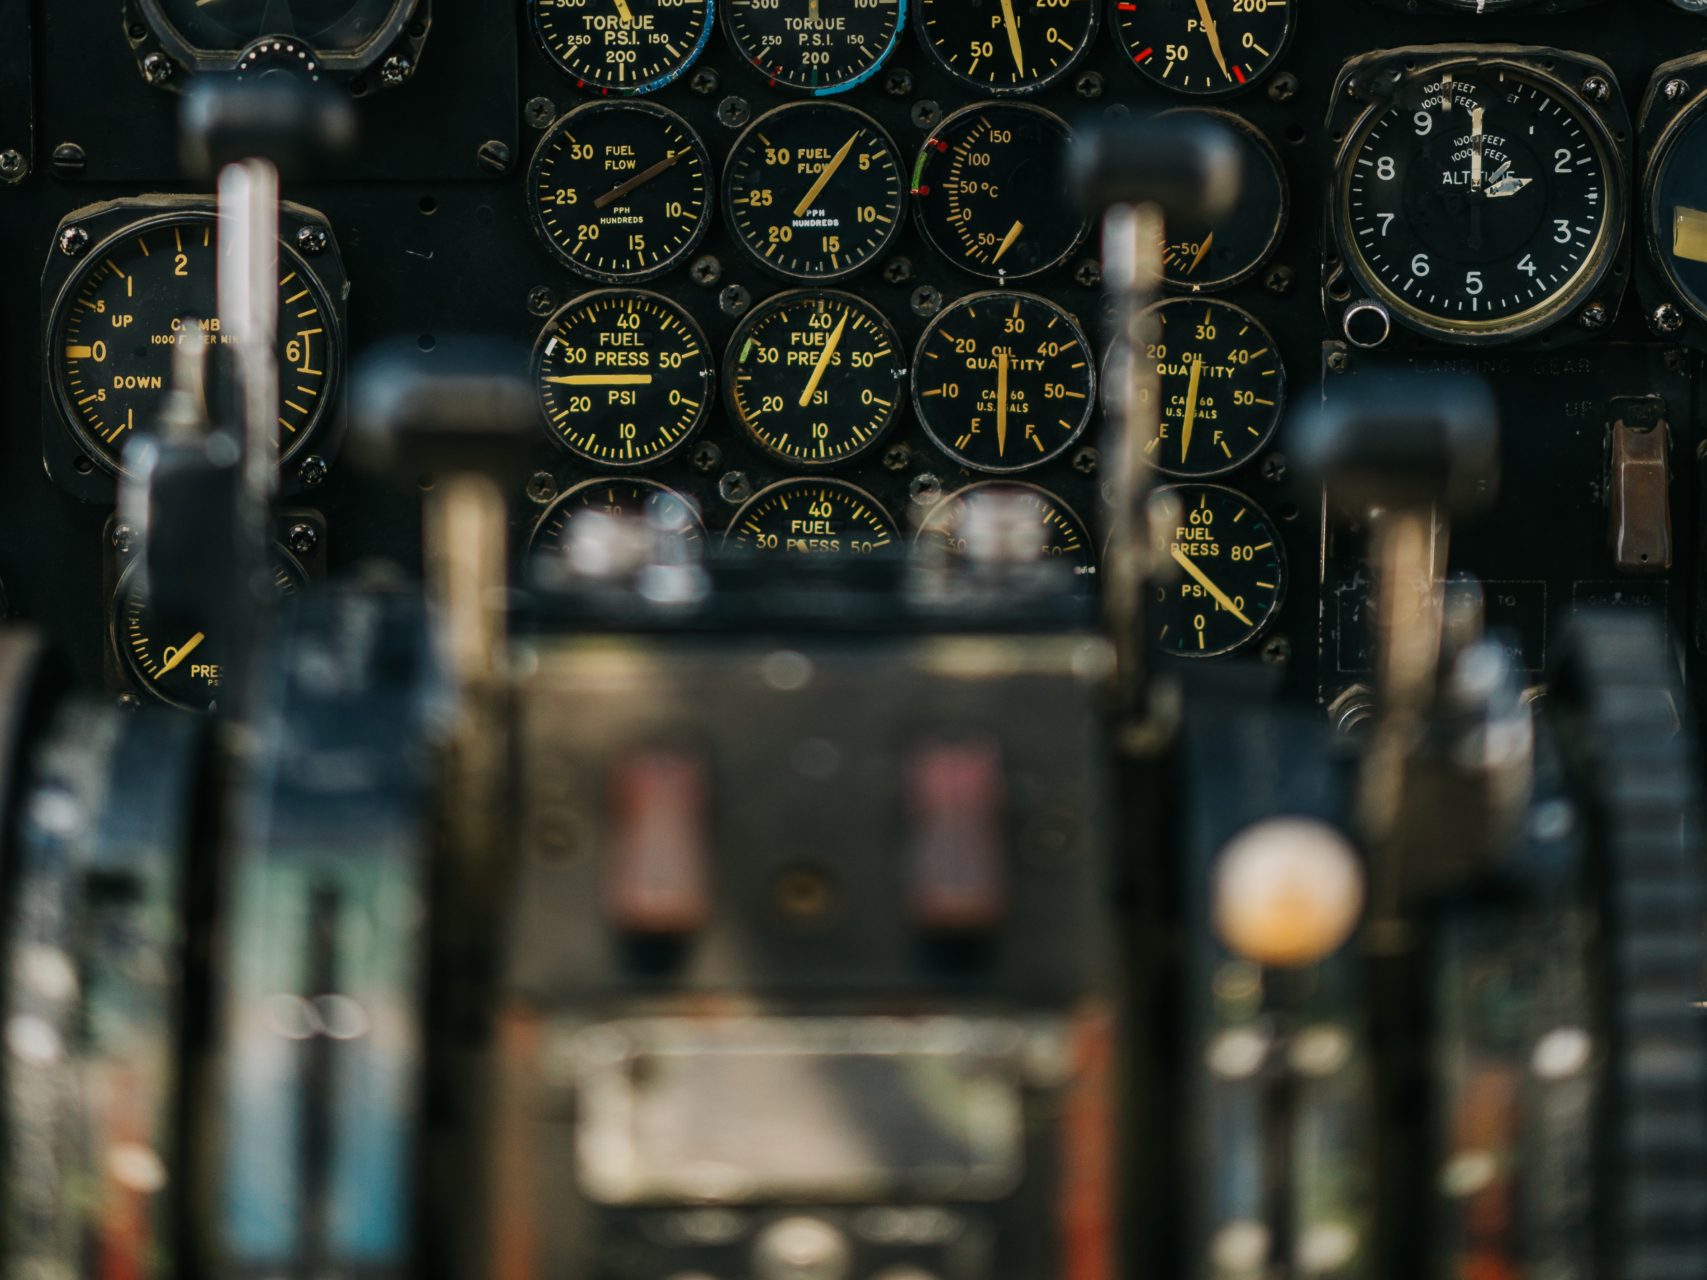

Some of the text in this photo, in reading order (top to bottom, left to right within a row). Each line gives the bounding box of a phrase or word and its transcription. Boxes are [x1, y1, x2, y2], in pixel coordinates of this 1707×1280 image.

[582, 16, 654, 30] TORQUE
[784, 18, 846, 30] TORQUE
[606, 51, 636, 63] 200
[802, 52, 830, 64] 200
[1452, 82, 1476, 93] FEET
[1455, 95, 1478, 109] FEET
[1414, 111, 1432, 135] 9
[1482, 135, 1505, 146] FEET
[606, 146, 635, 155] FUEL
[798, 149, 831, 159] FUEL
[1485, 149, 1508, 161] FEET
[605, 160, 636, 169] FLOW
[1554, 149, 1572, 172] 2
[1376, 156, 1395, 180] 8
[960, 181, 977, 193] 50
[556, 189, 577, 204] 25
[751, 190, 772, 206] 25
[1376, 213, 1394, 236] 7
[1554, 220, 1571, 243] 3
[629, 235, 645, 250] 15
[823, 236, 840, 252] 15
[175, 255, 188, 276] 2
[1412, 254, 1430, 276] 6
[1517, 254, 1536, 276] 4
[1466, 272, 1483, 294] 5
[112, 315, 133, 327] UP
[171, 319, 220, 331] CMB
[151, 335, 175, 344] 1000
[600, 333, 644, 346] FUEL
[956, 339, 976, 353] 20
[92, 341, 106, 362] 0
[286, 341, 300, 361] 6
[564, 348, 587, 363] 30
[992, 346, 1015, 357] OIL
[595, 352, 649, 366] PRESS
[788, 352, 841, 365] PRES
[851, 352, 873, 367] 50
[966, 358, 1044, 370] QUATITY
[1157, 364, 1235, 378] QUATITY
[114, 376, 161, 388] DOWN
[609, 391, 635, 405] PSI
[1044, 384, 1065, 398] 50
[1234, 391, 1253, 405] 50
[1006, 403, 1029, 412] ALS
[620, 423, 636, 438] 10
[972, 418, 980, 432] E
[1026, 425, 1034, 438] F
[1160, 424, 1168, 438] E
[1214, 431, 1222, 444] F
[809, 501, 832, 518] 40
[792, 521, 836, 534] FUEL
[1176, 528, 1213, 540] FUEL
[787, 539, 839, 552] PESS
[1171, 543, 1219, 556] PRESS
